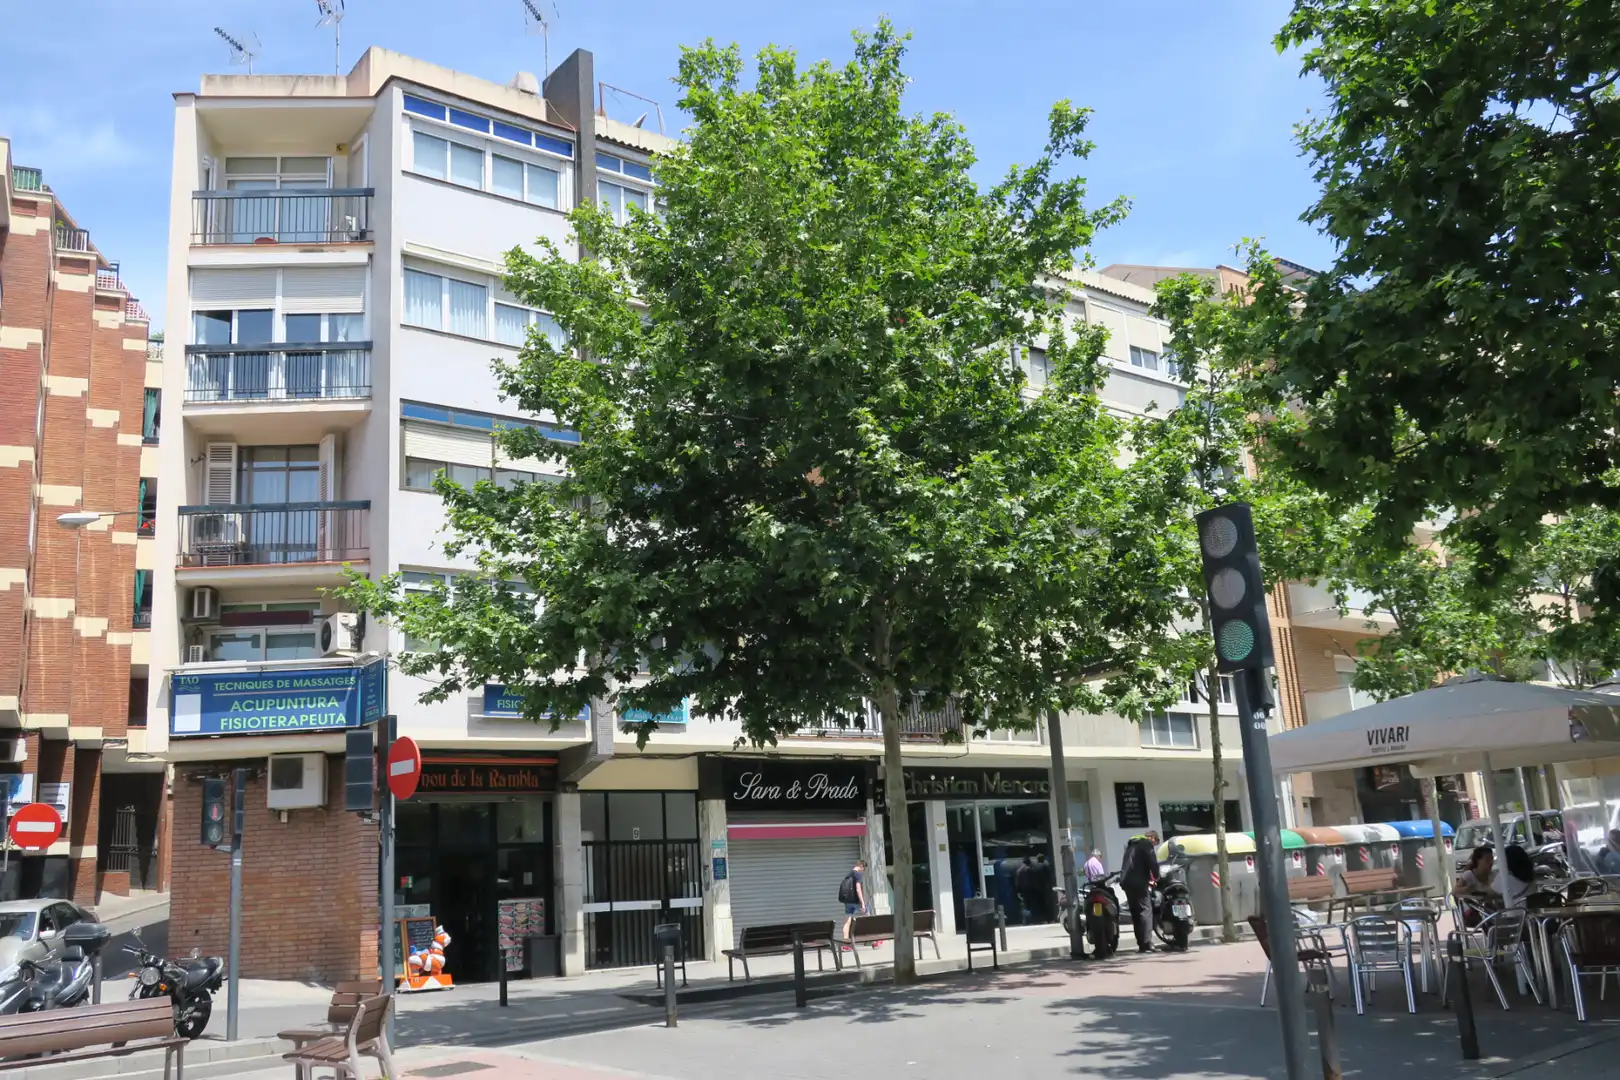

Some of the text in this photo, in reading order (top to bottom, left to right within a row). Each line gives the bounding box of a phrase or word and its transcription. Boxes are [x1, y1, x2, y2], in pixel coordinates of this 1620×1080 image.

[179, 676, 200, 685] TAO
[214, 676, 356, 692] TECNIQUES DE MASSATGES
[230, 696, 340, 712] ACUPUNTURA
[220, 713, 347, 730] FISIOTERAPEUTA
[1367, 725, 1410, 746] VIVARI
[451, 768, 467, 787] de
[470, 768, 484, 787] la
[488, 768, 540, 789] Rambla
[733, 771, 782, 800] Sara
[786, 779, 802, 799] &
[804, 773, 860, 800] Prado
